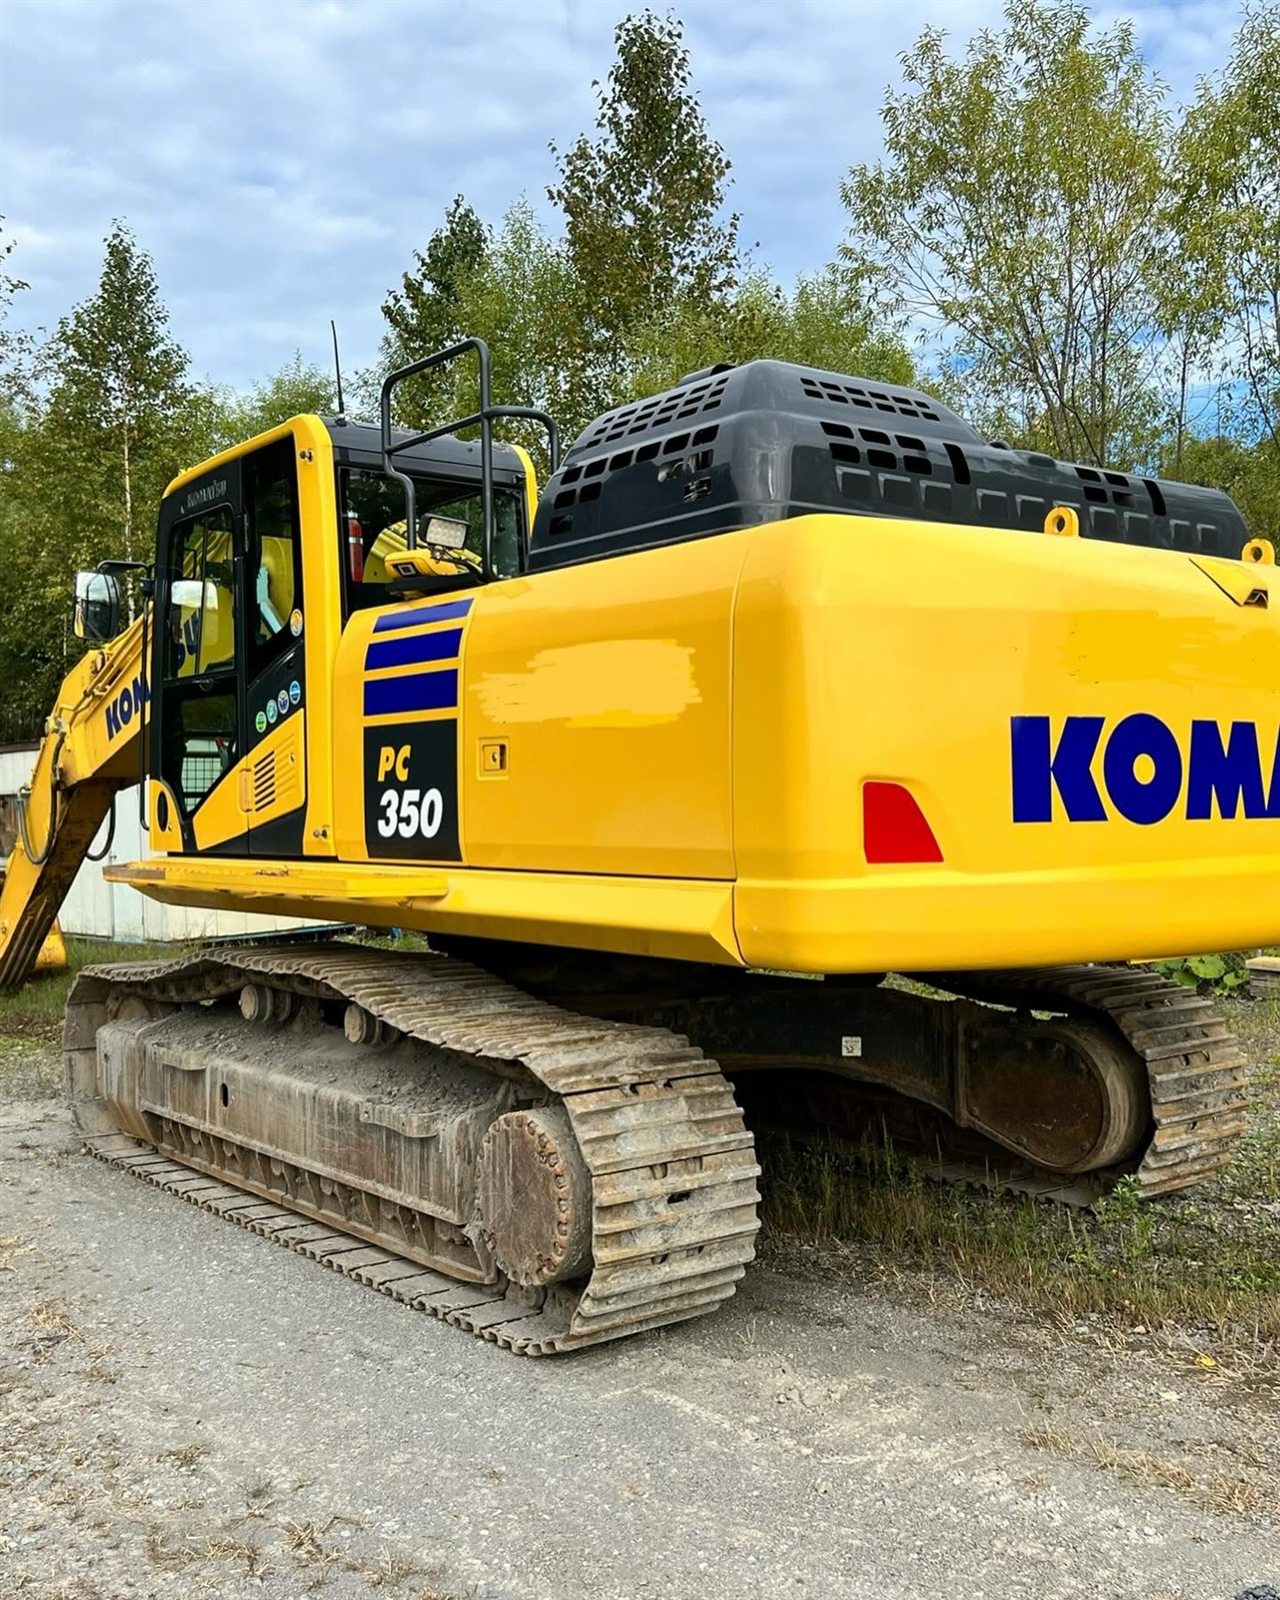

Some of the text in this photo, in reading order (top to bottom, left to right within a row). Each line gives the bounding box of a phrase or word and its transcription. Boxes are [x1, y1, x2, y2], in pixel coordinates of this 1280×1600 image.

[378, 745, 411, 782] PC
[1010, 713, 1280, 825] KOM
[378, 788, 443, 838] 350
